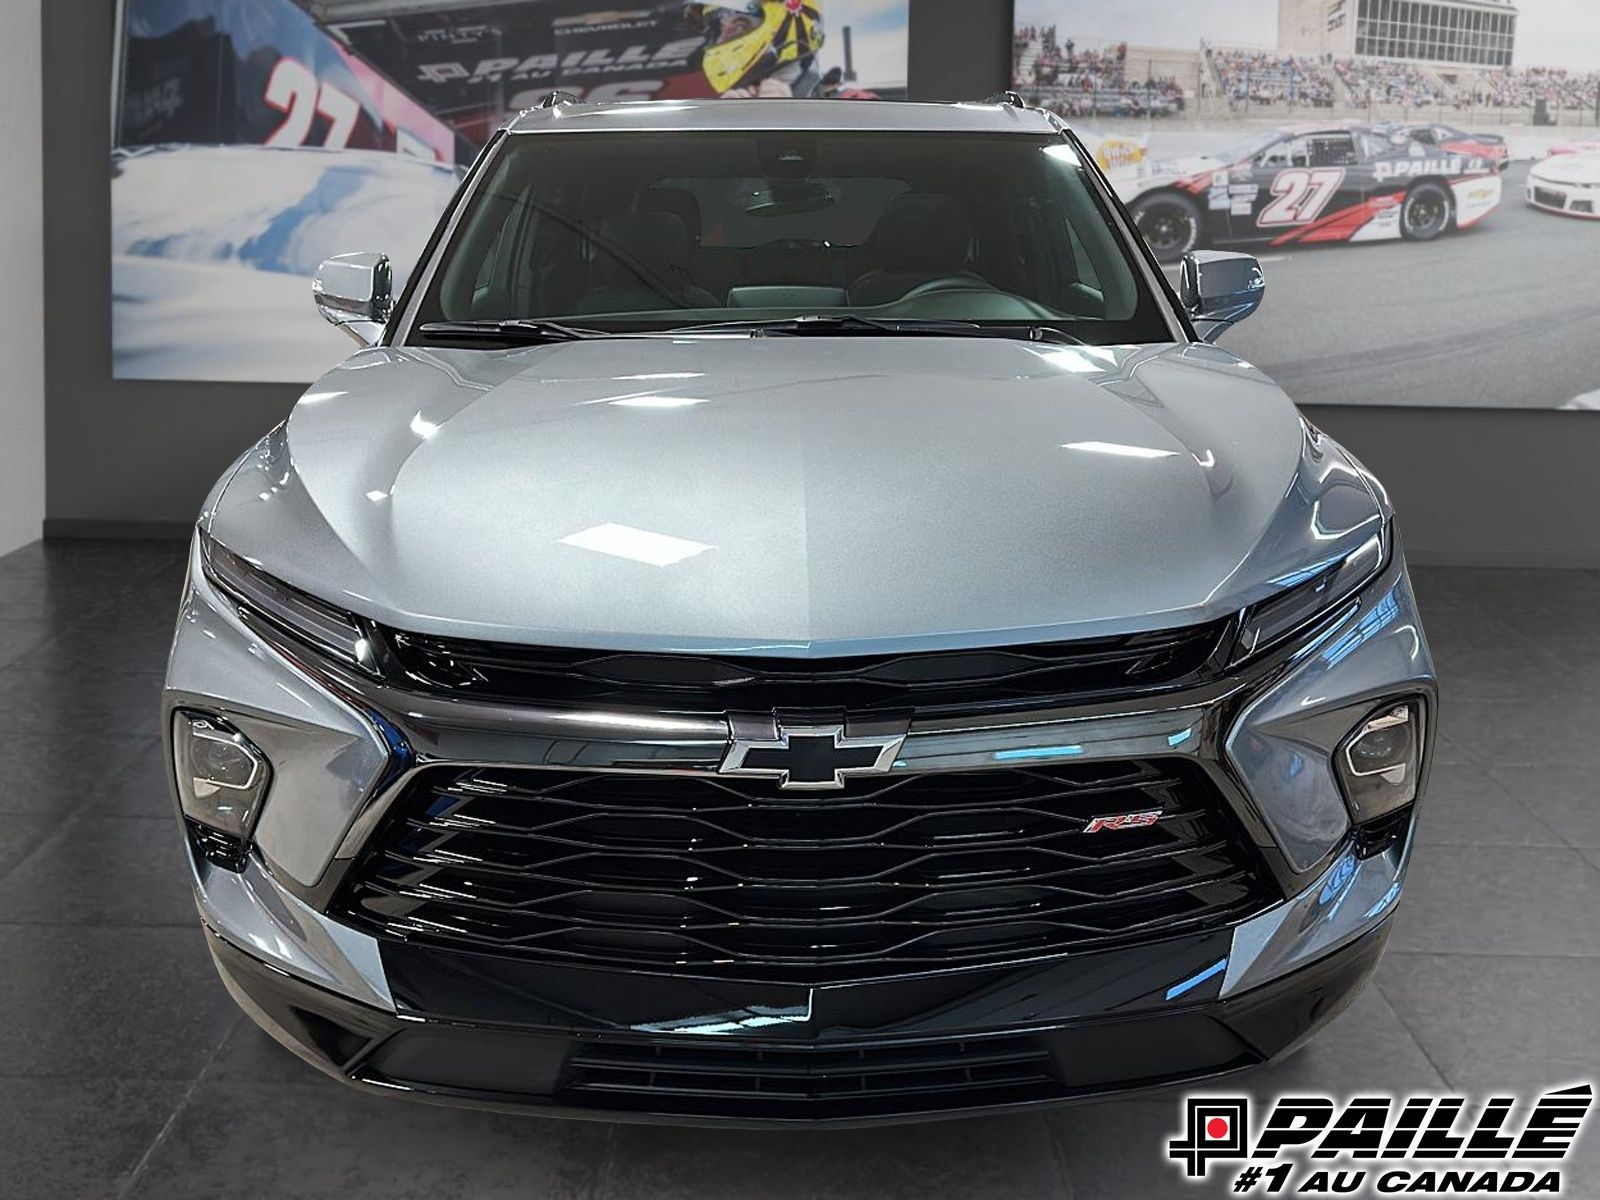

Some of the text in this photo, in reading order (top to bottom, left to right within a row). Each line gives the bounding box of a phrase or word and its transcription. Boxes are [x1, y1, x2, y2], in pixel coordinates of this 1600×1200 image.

[562, 59, 687, 76] CANADA
[264, 56, 361, 150] 27
[1256, 166, 1347, 228] 27
[1083, 810, 1163, 833] RS
